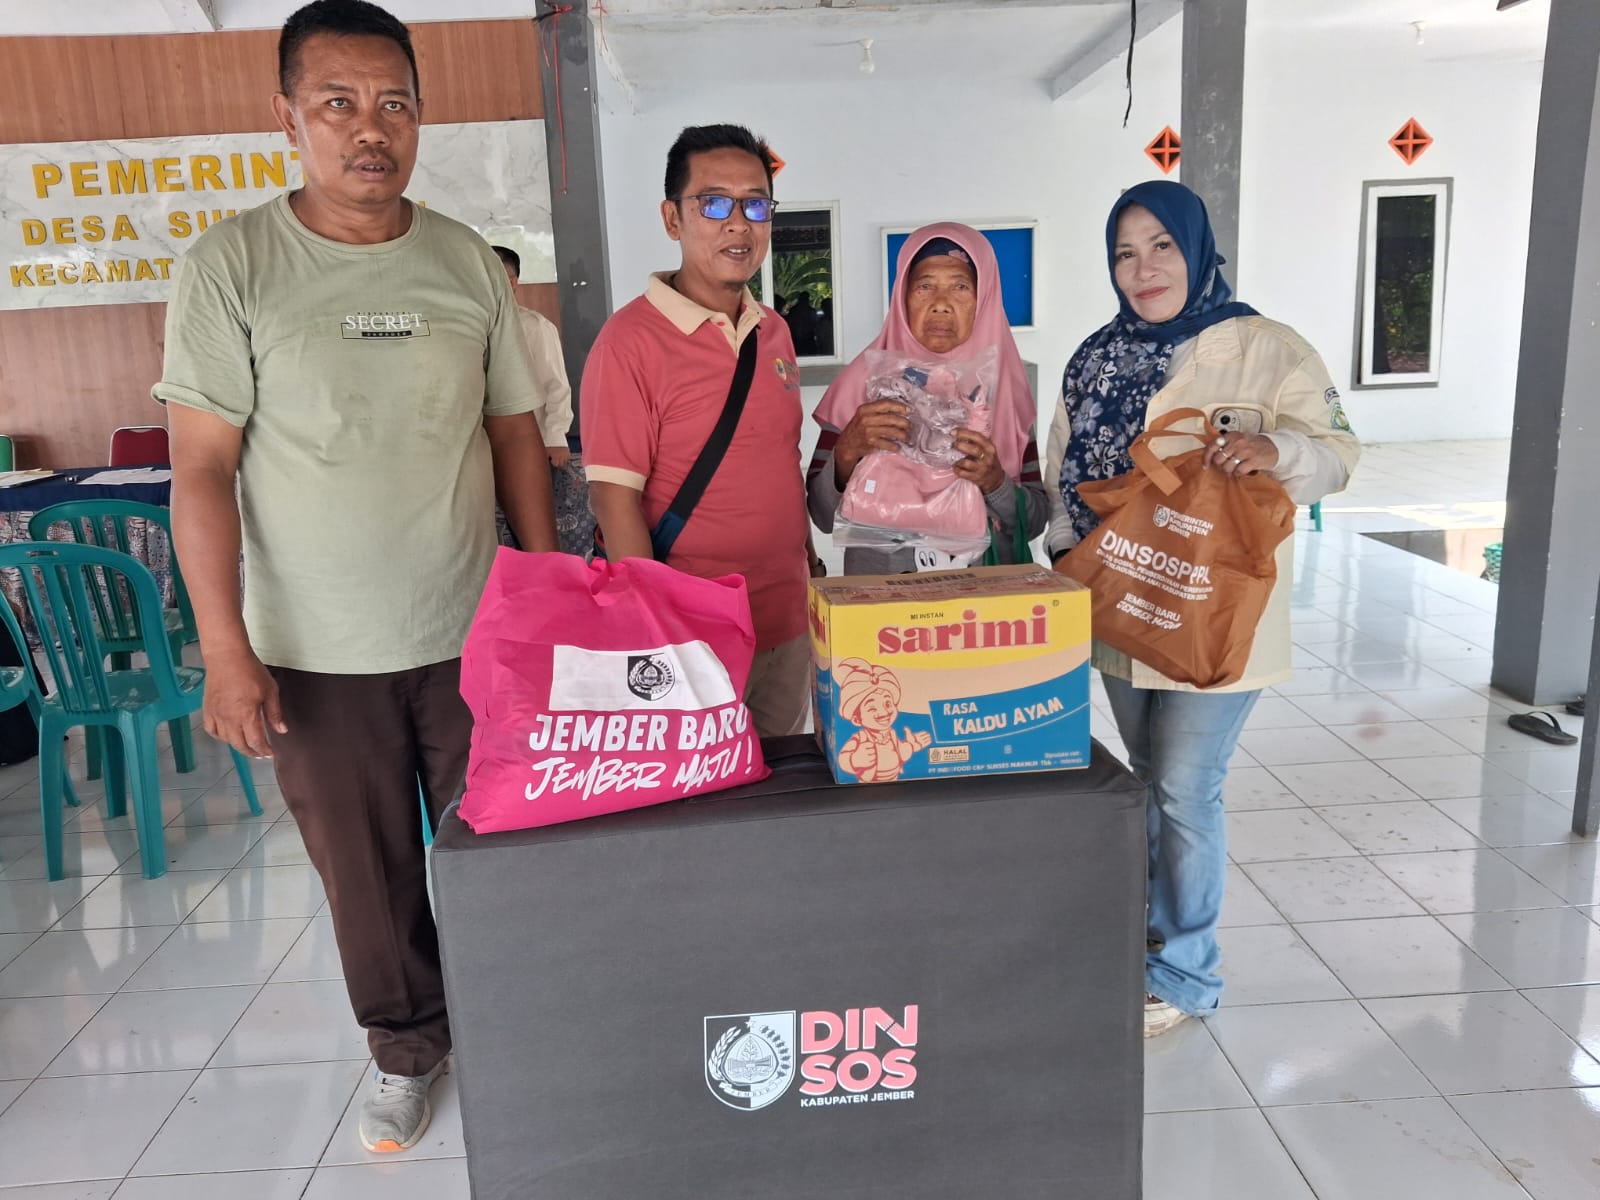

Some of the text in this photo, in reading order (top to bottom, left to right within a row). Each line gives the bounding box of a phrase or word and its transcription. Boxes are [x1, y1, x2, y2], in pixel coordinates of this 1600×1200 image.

[32, 152, 301, 199] PEMERIN
[22, 213, 138, 246] DESA
[345, 313, 423, 330] SECRET
[919, 611, 944, 620] INSTAN
[1124, 592, 1180, 622] JEMBER BARU
[877, 604, 1048, 656] sarimi
[943, 702, 978, 716] RASA
[953, 697, 1064, 735] KALDU AYAM
[528, 713, 669, 752] JEMBER
[525, 756, 666, 800] JEMBER
[800, 1004, 918, 1054] DIN
[799, 1048, 917, 1096] SOS
[800, 1090, 915, 1108] KABUPATEN JEMBER
